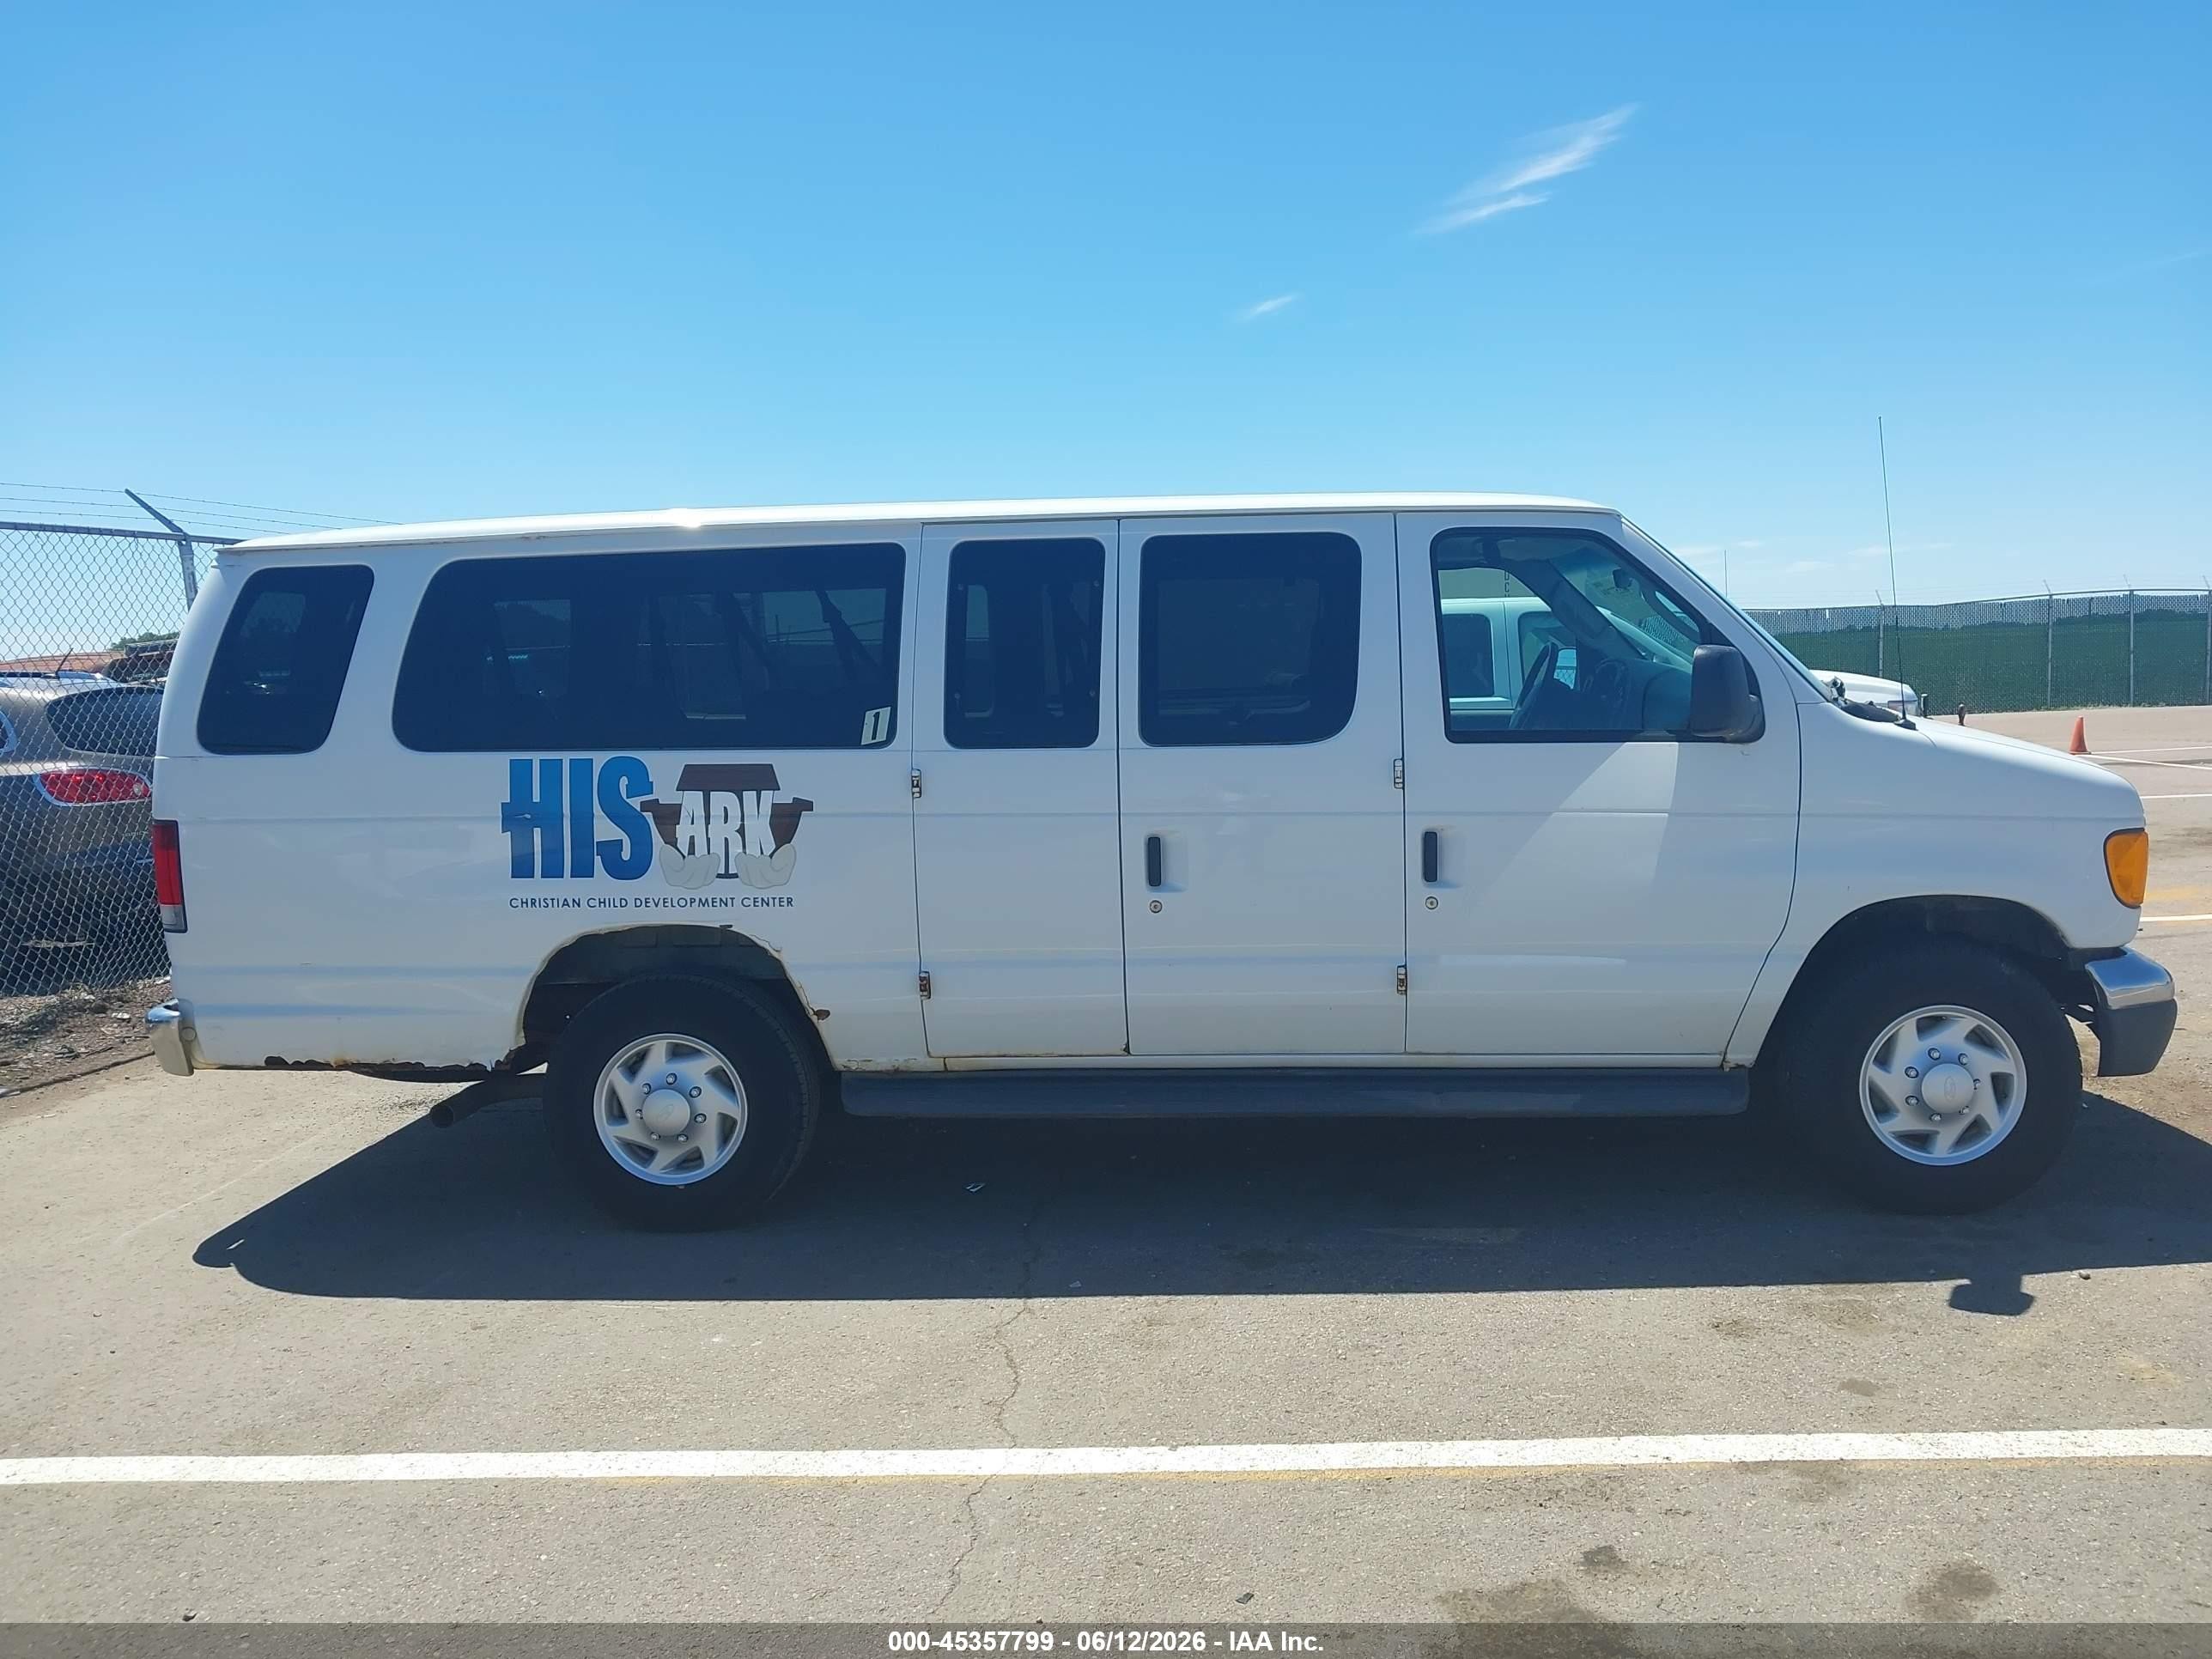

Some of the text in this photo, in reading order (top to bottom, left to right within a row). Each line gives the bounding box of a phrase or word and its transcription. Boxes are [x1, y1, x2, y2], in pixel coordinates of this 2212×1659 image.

[872, 711, 880, 740] 1
[501, 756, 776, 880] HIS ARK
[509, 896, 794, 908] CHRISTIAN CHILD DEVELOPMENT CENTER
